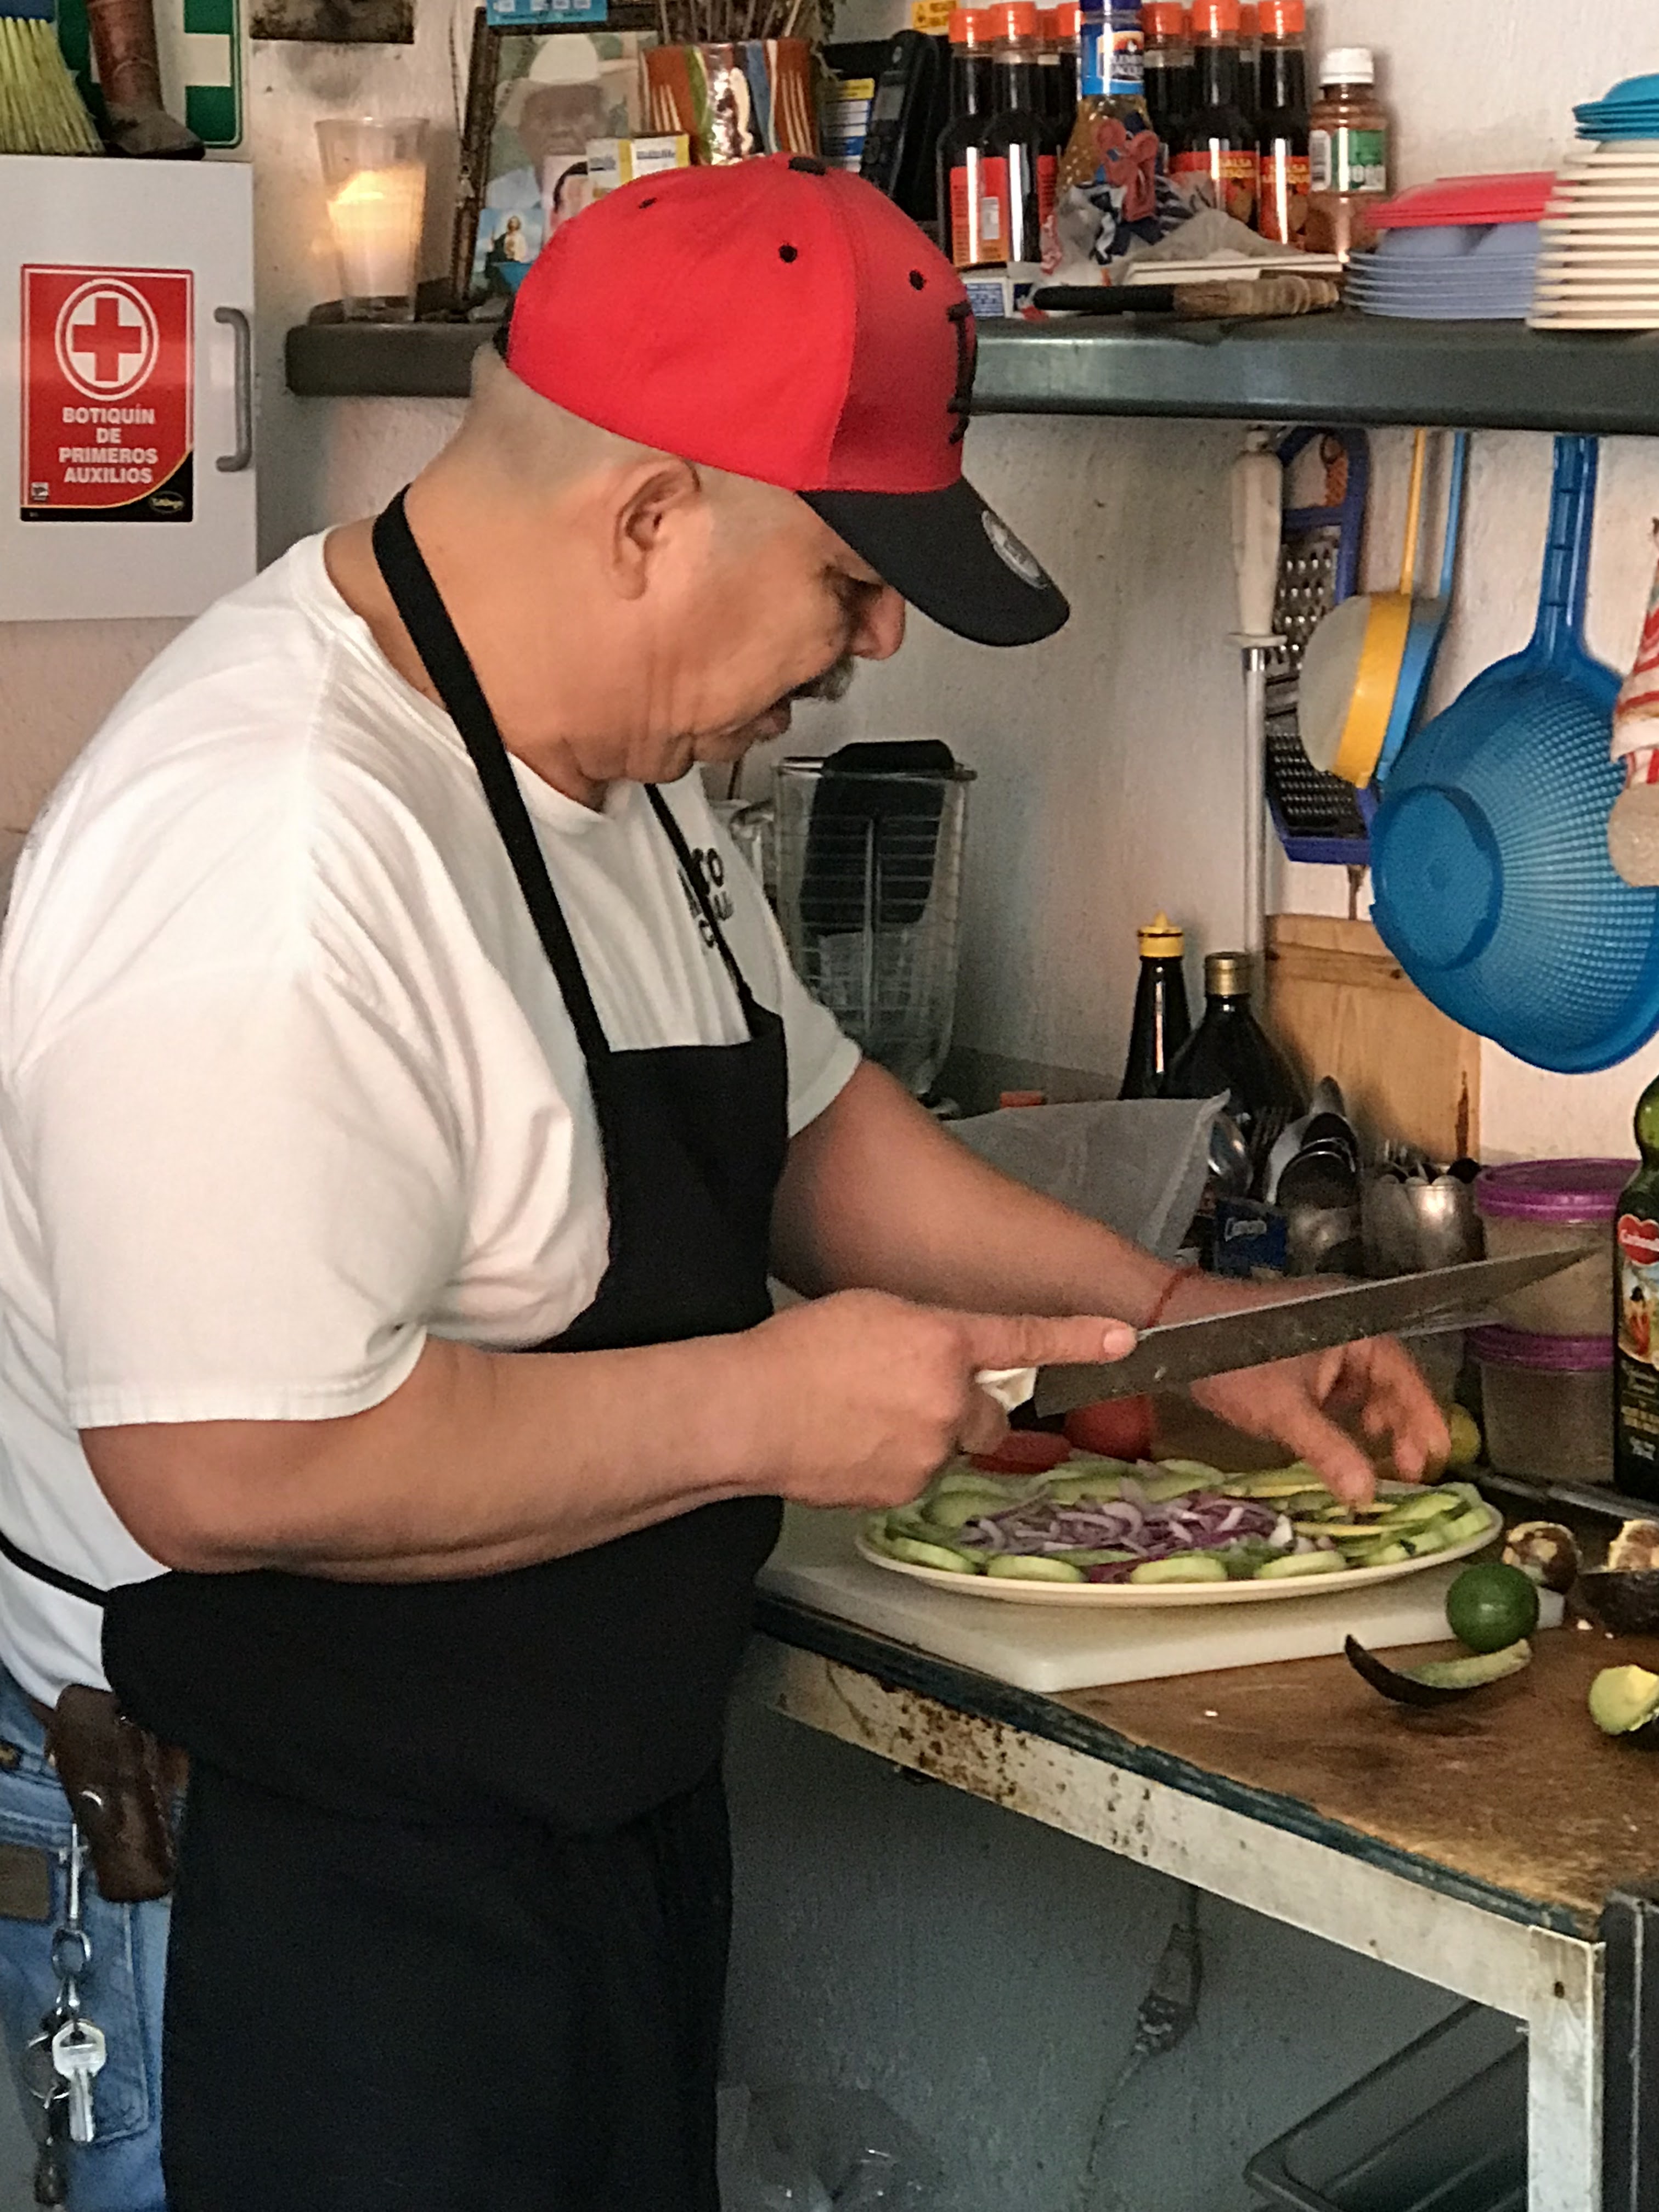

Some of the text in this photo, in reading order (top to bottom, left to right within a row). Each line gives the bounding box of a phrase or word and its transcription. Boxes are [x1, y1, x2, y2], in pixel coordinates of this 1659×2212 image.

[62, 403, 156, 425] BOTIQUÍN
[95, 427, 122, 444] DE
[58, 447, 159, 464] PRIMEROS
[63, 466, 153, 484] AUXILIOS
